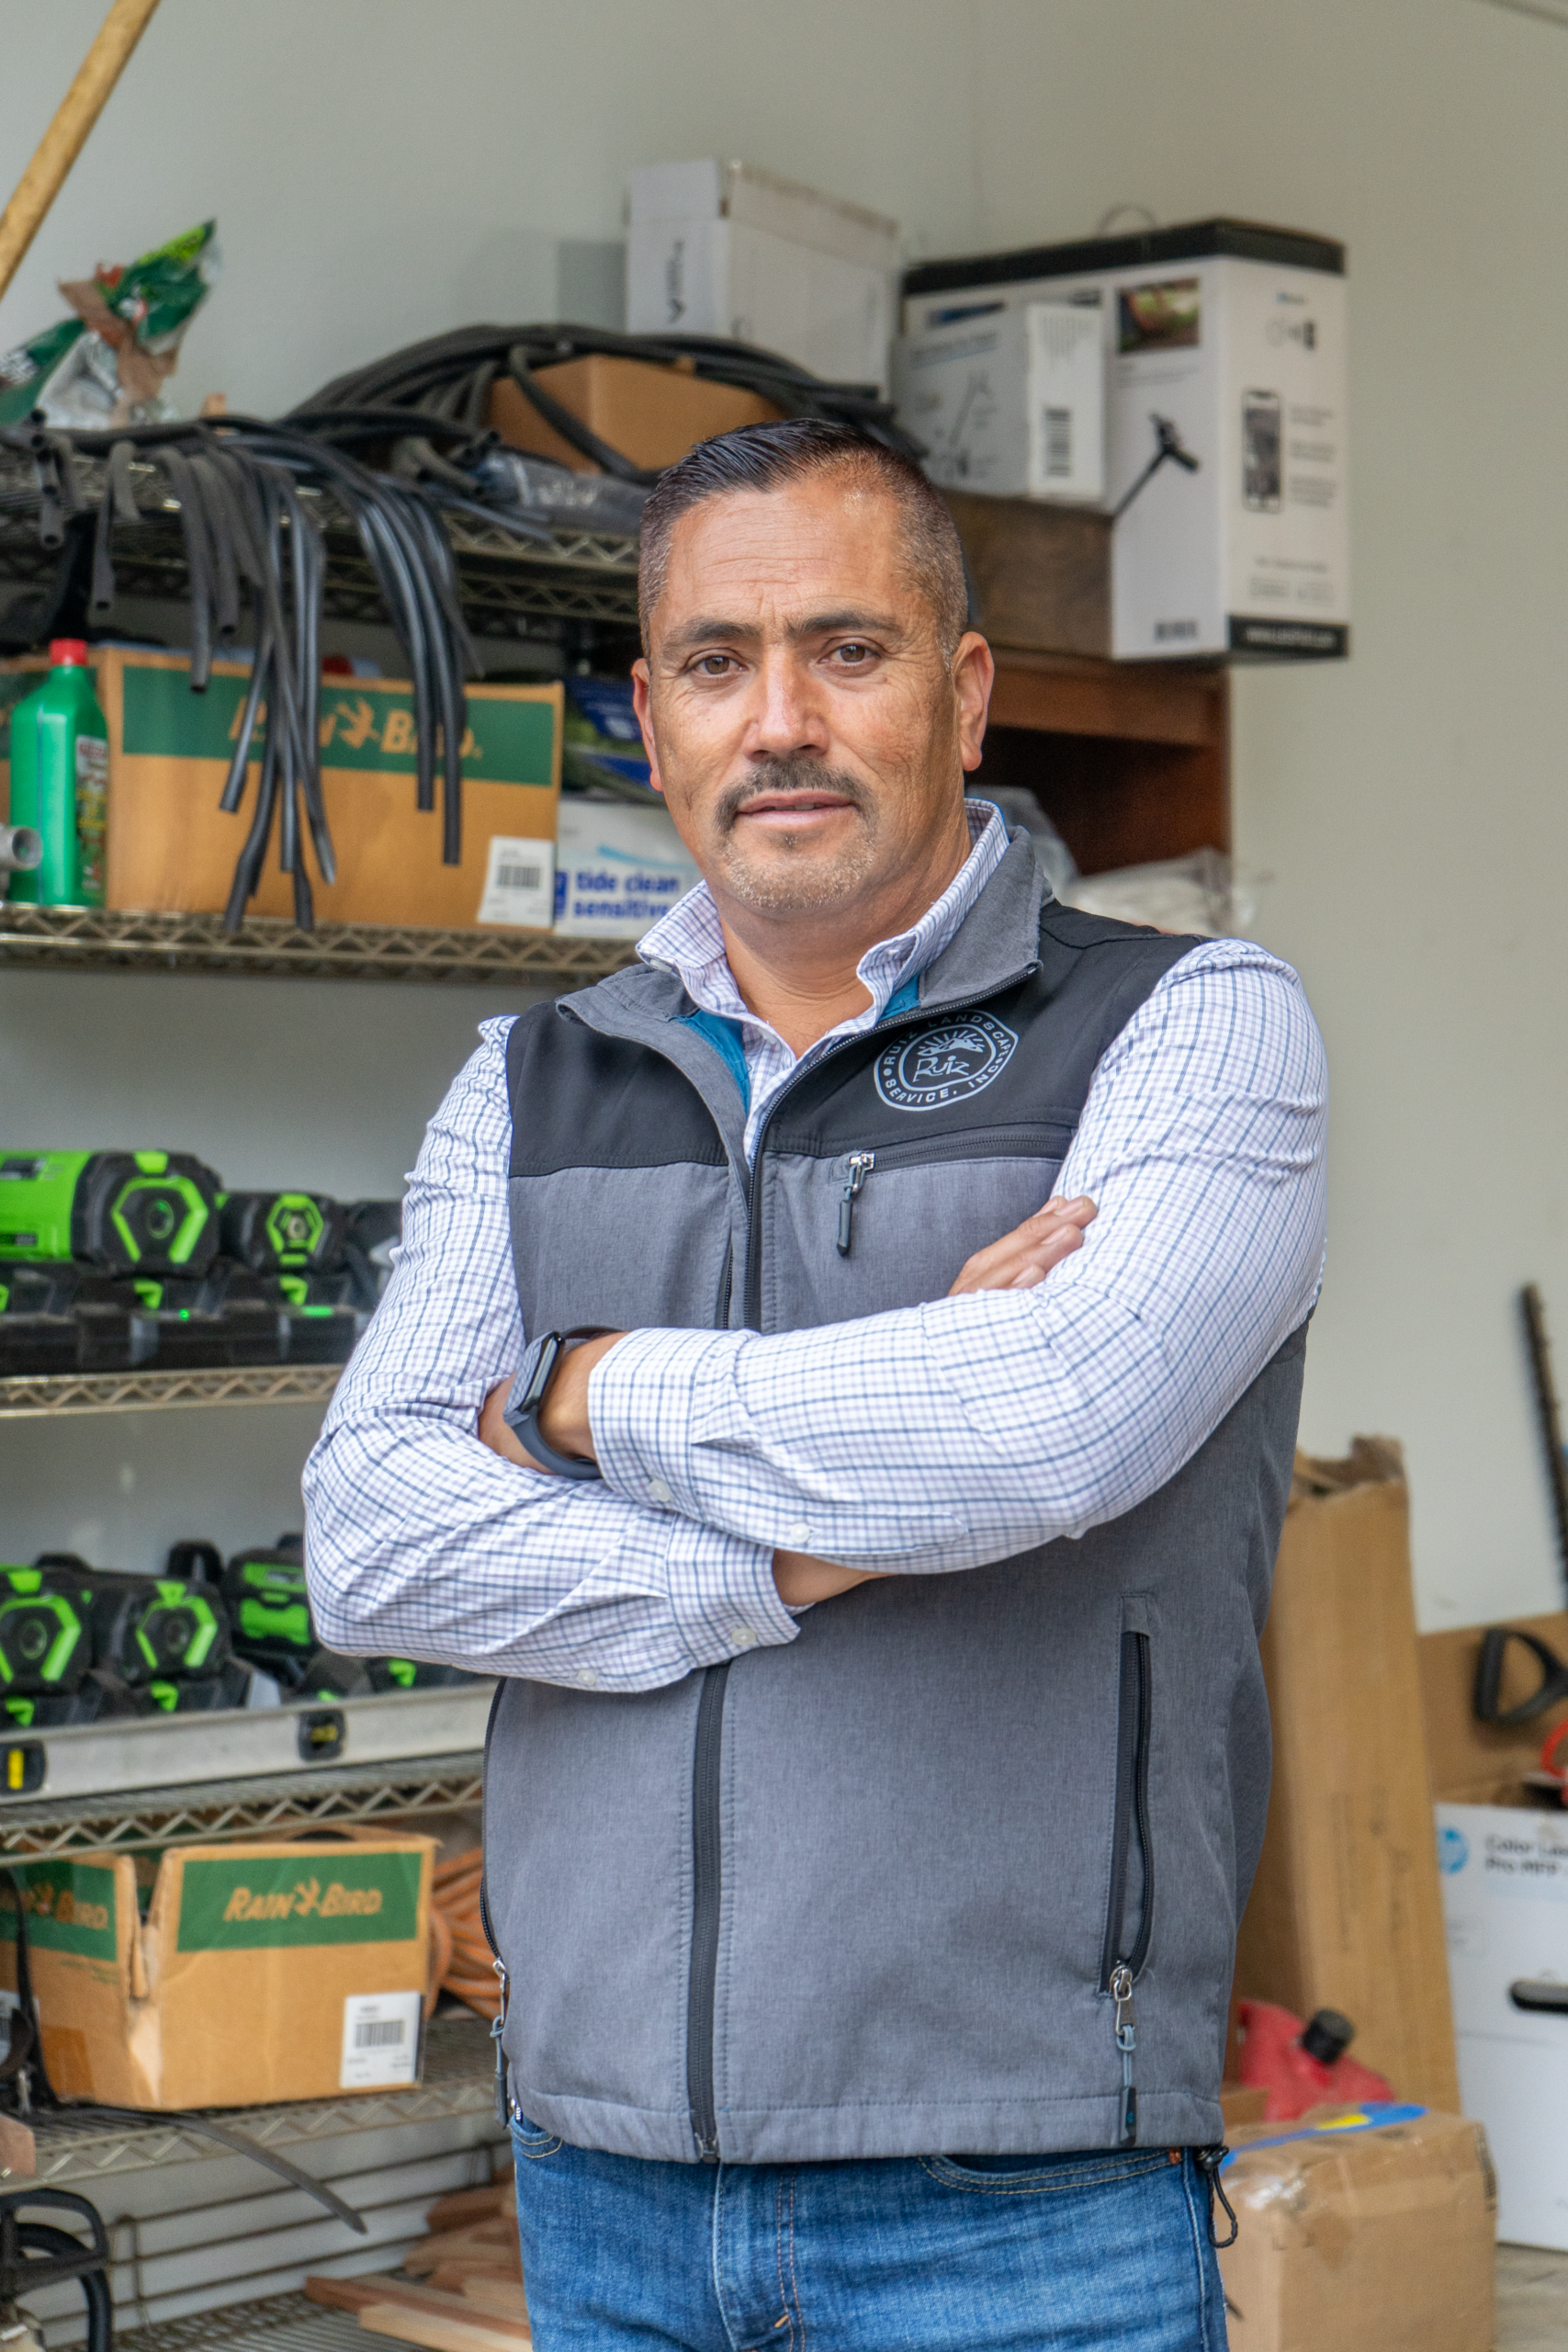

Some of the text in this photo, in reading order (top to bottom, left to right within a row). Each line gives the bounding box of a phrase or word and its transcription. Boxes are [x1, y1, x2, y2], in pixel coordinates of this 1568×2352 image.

[576, 870, 679, 893] tide clean
[884, 1013, 1011, 1065] RUIZ LANDSCAPE
